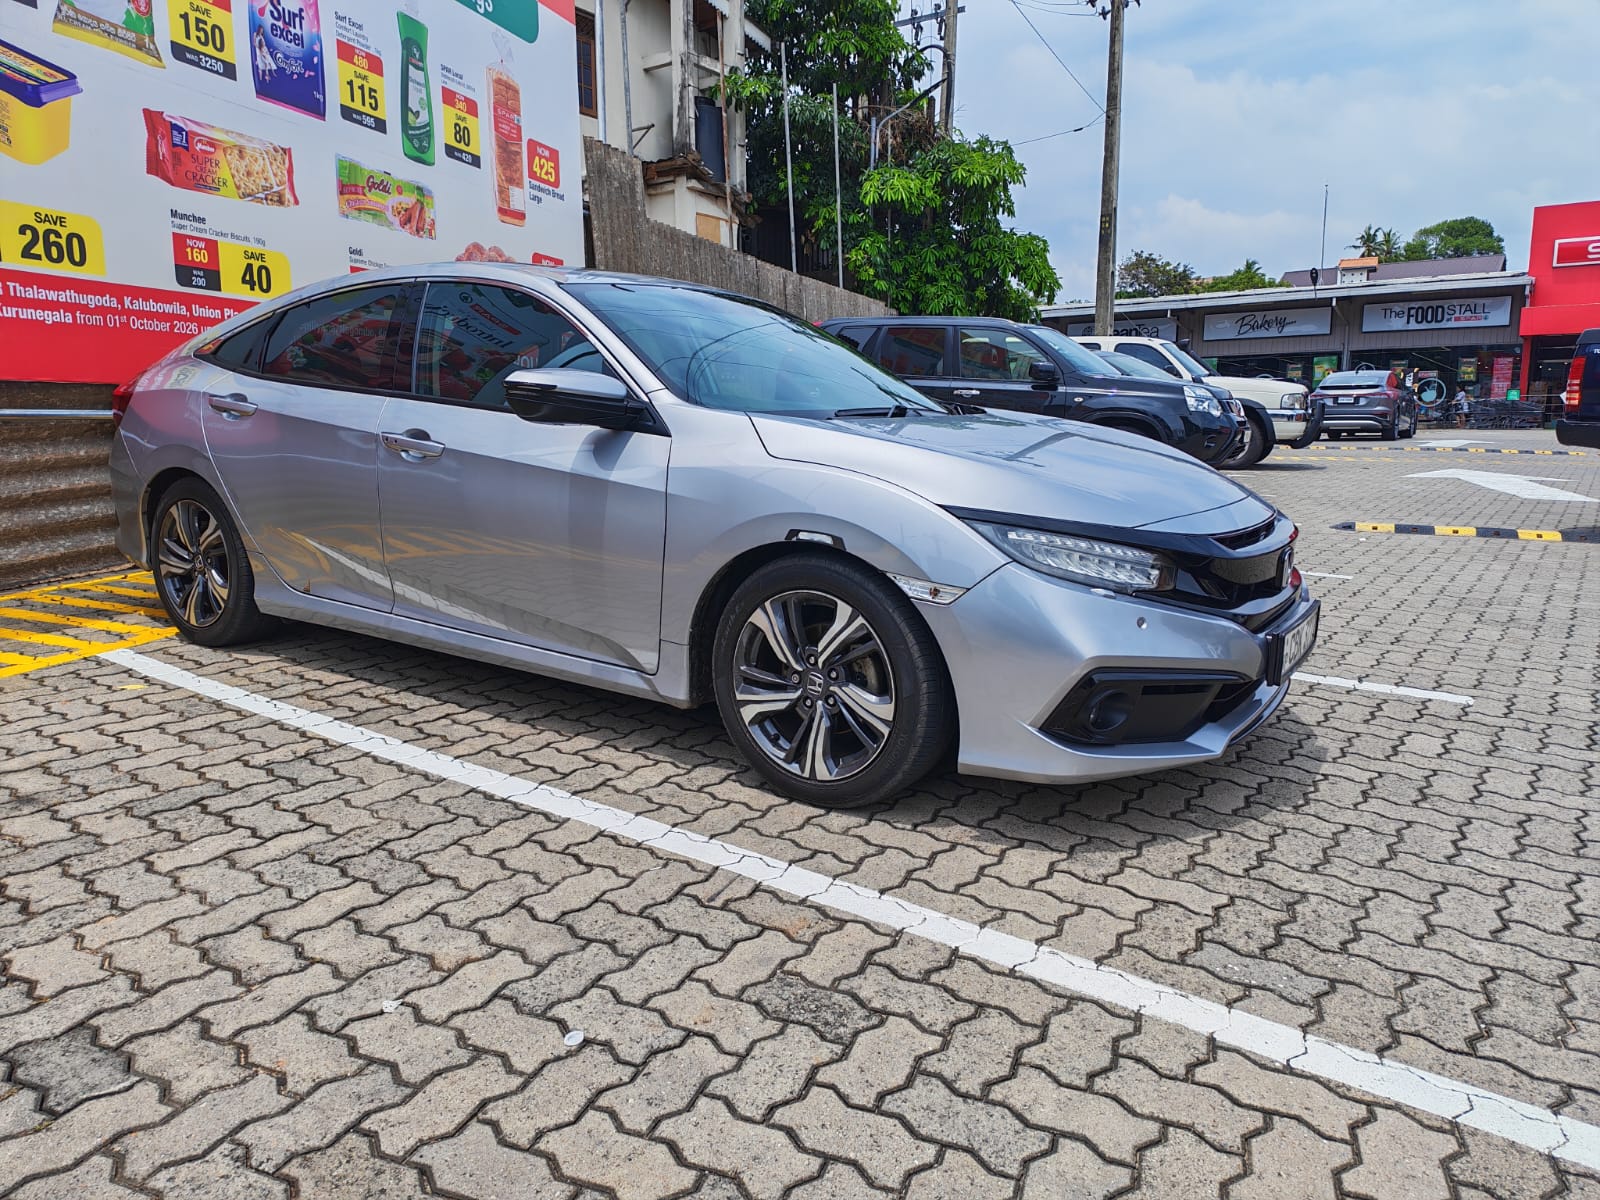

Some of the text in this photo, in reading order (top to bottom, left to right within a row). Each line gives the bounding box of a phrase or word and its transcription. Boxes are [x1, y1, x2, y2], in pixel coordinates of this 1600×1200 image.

[189, 2, 213, 19] SAVE
[269, 0, 305, 31] Surf
[178, 11, 225, 53] 150
[270, 22, 305, 49] excel
[354, 47, 367, 57] NOW
[184, 51, 224, 73] WAS 3250
[273, 50, 305, 74] Comfort
[353, 54, 369, 70] 480
[353, 69, 370, 84] SAVE
[346, 79, 379, 112] 115
[454, 99, 467, 113] 340
[362, 114, 375, 128] 595
[455, 112, 468, 125] SAVE
[453, 122, 471, 147] 80
[462, 151, 473, 164] 420
[536, 145, 550, 158] NOW
[191, 153, 220, 168] SUPER
[532, 155, 556, 183] 425
[185, 169, 229, 188] CRACKER
[195, 165, 217, 176] CREAM
[366, 174, 392, 195] Goldi
[34, 211, 67, 228] SAVE
[170, 208, 207, 225] Munchee
[171, 220, 188, 232] Super
[189, 224, 207, 235] Cream
[18, 223, 87, 267] 260
[186, 238, 206, 249] NOW
[185, 246, 209, 264] 160
[243, 249, 267, 263] SAVE
[191, 276, 206, 287] 200
[241, 262, 272, 294] 40
[6, 281, 122, 310] Thalawathugoda,
[123, 295, 190, 317] Kalubowila,
[192, 303, 221, 319] Union
[76, 310, 103, 326] from
[129, 315, 171, 332] October
[174, 320, 198, 335] 2026
[1381, 303, 1491, 325] The FOOD STALL
